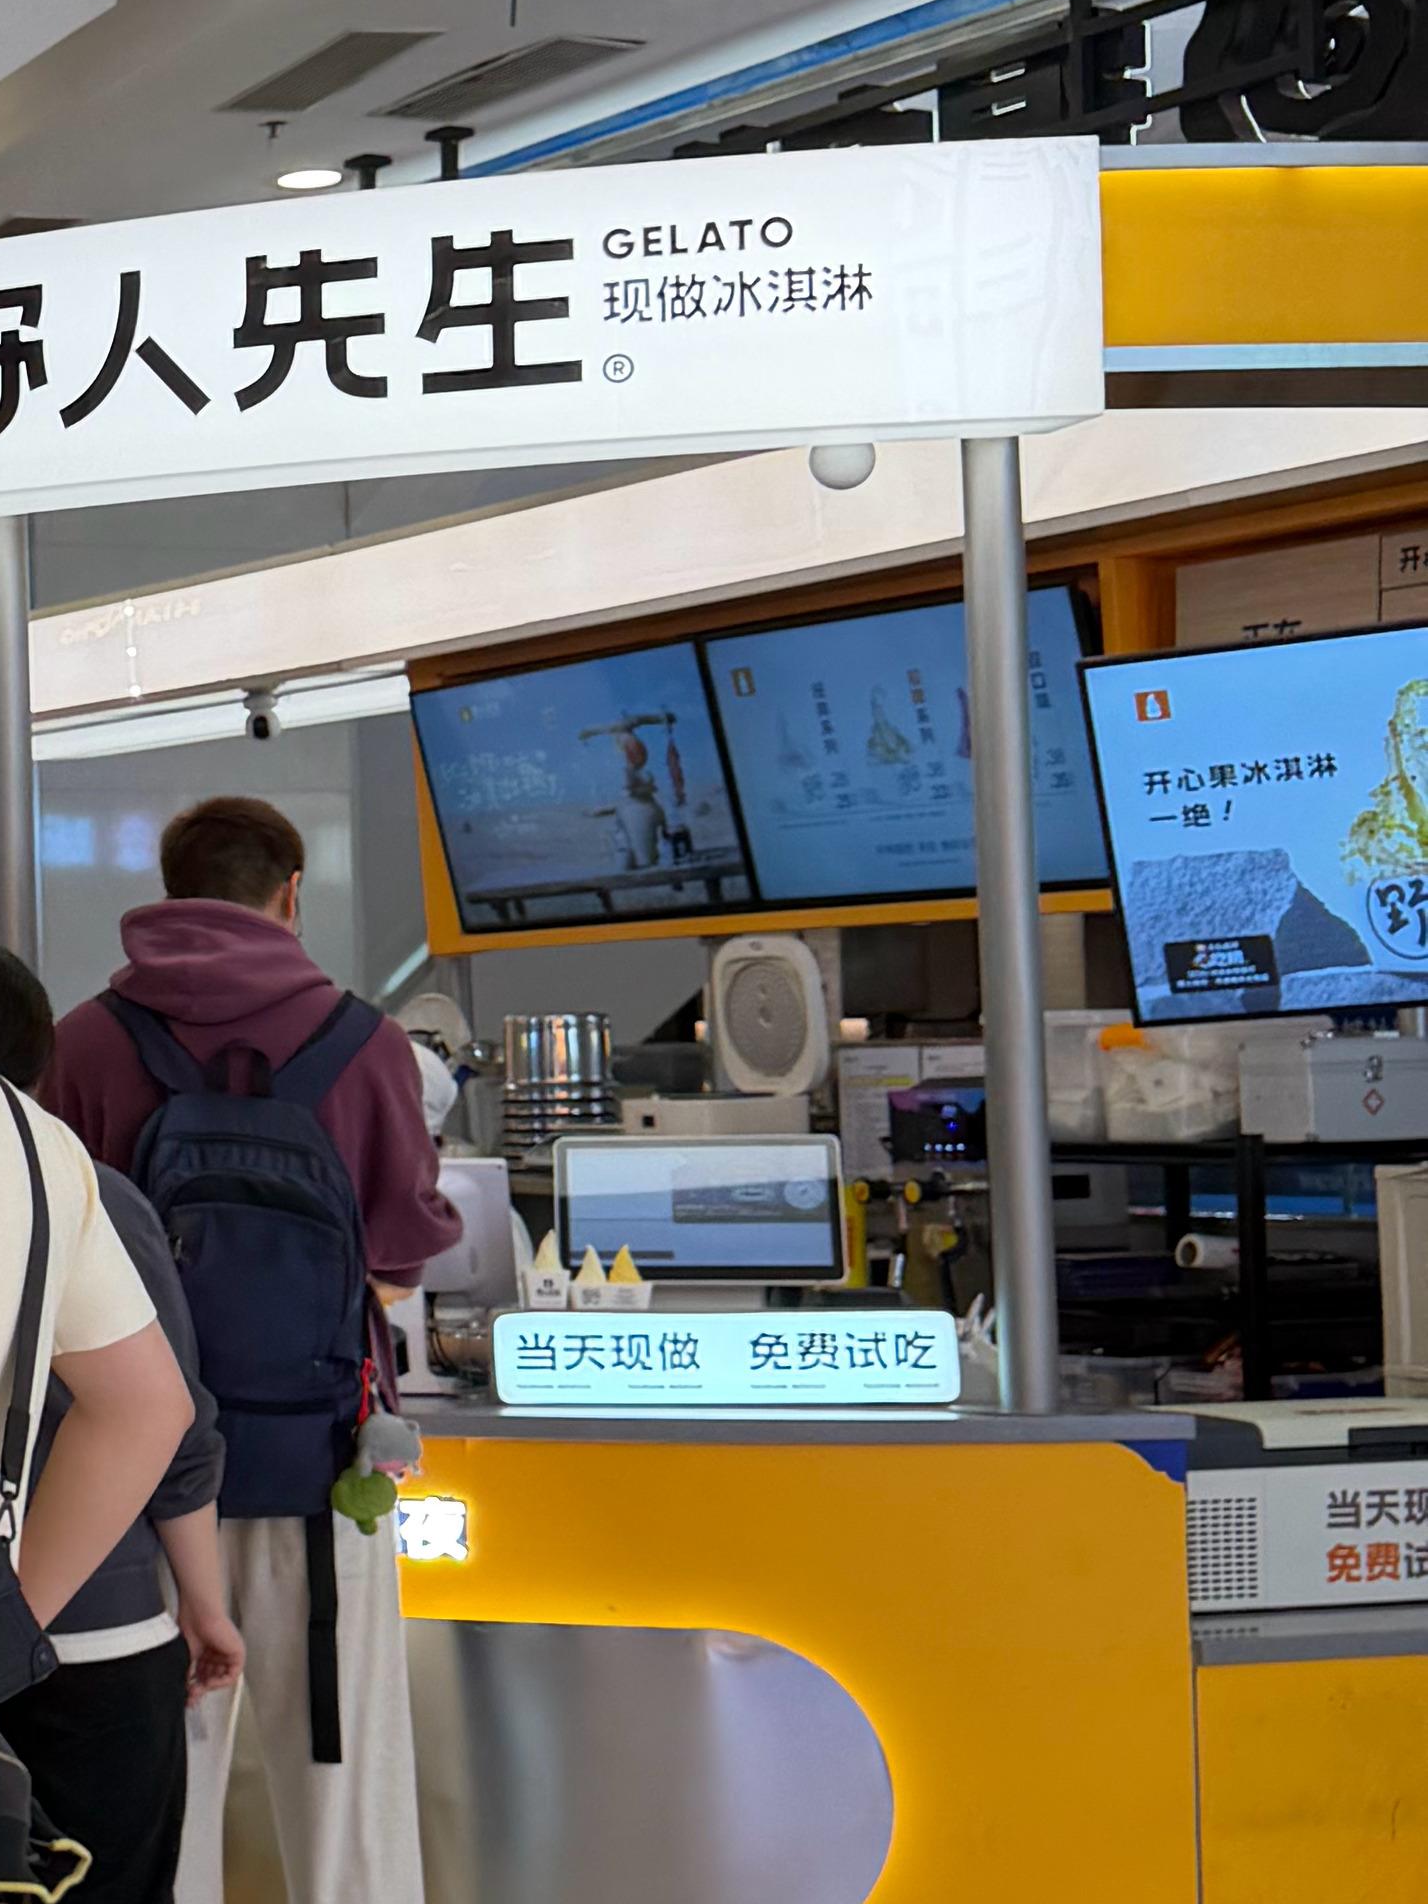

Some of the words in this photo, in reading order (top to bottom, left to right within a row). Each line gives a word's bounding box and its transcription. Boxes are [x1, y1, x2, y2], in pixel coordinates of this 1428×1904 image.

[602, 216, 794, 261] GELATO
[602, 262, 873, 324] 现做冰淇淋
[1400, 546, 1428, 574] 开
[1143, 753, 1338, 796] 开心果冰淇淋
[516, 1332, 700, 1371] 当天现做
[749, 1332, 937, 1371] 免费试吃
